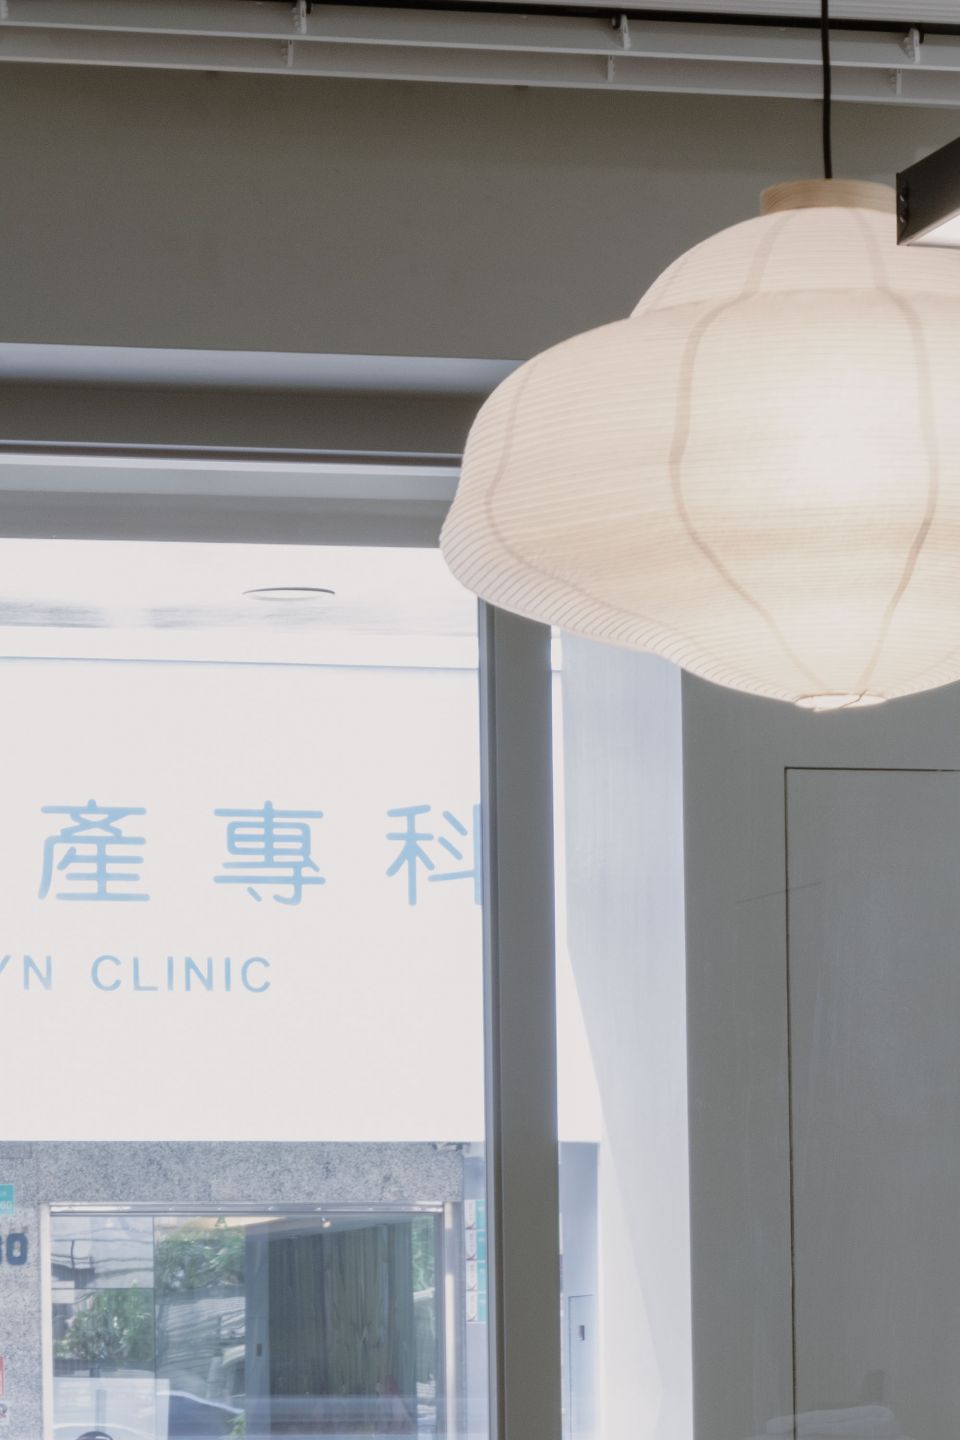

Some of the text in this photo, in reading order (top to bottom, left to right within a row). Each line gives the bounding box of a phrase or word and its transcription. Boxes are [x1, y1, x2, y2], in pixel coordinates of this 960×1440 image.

[38, 798, 482, 906] 產專科
[91, 955, 271, 993] CLINIC
[0, 1232, 28, 1266] 0
